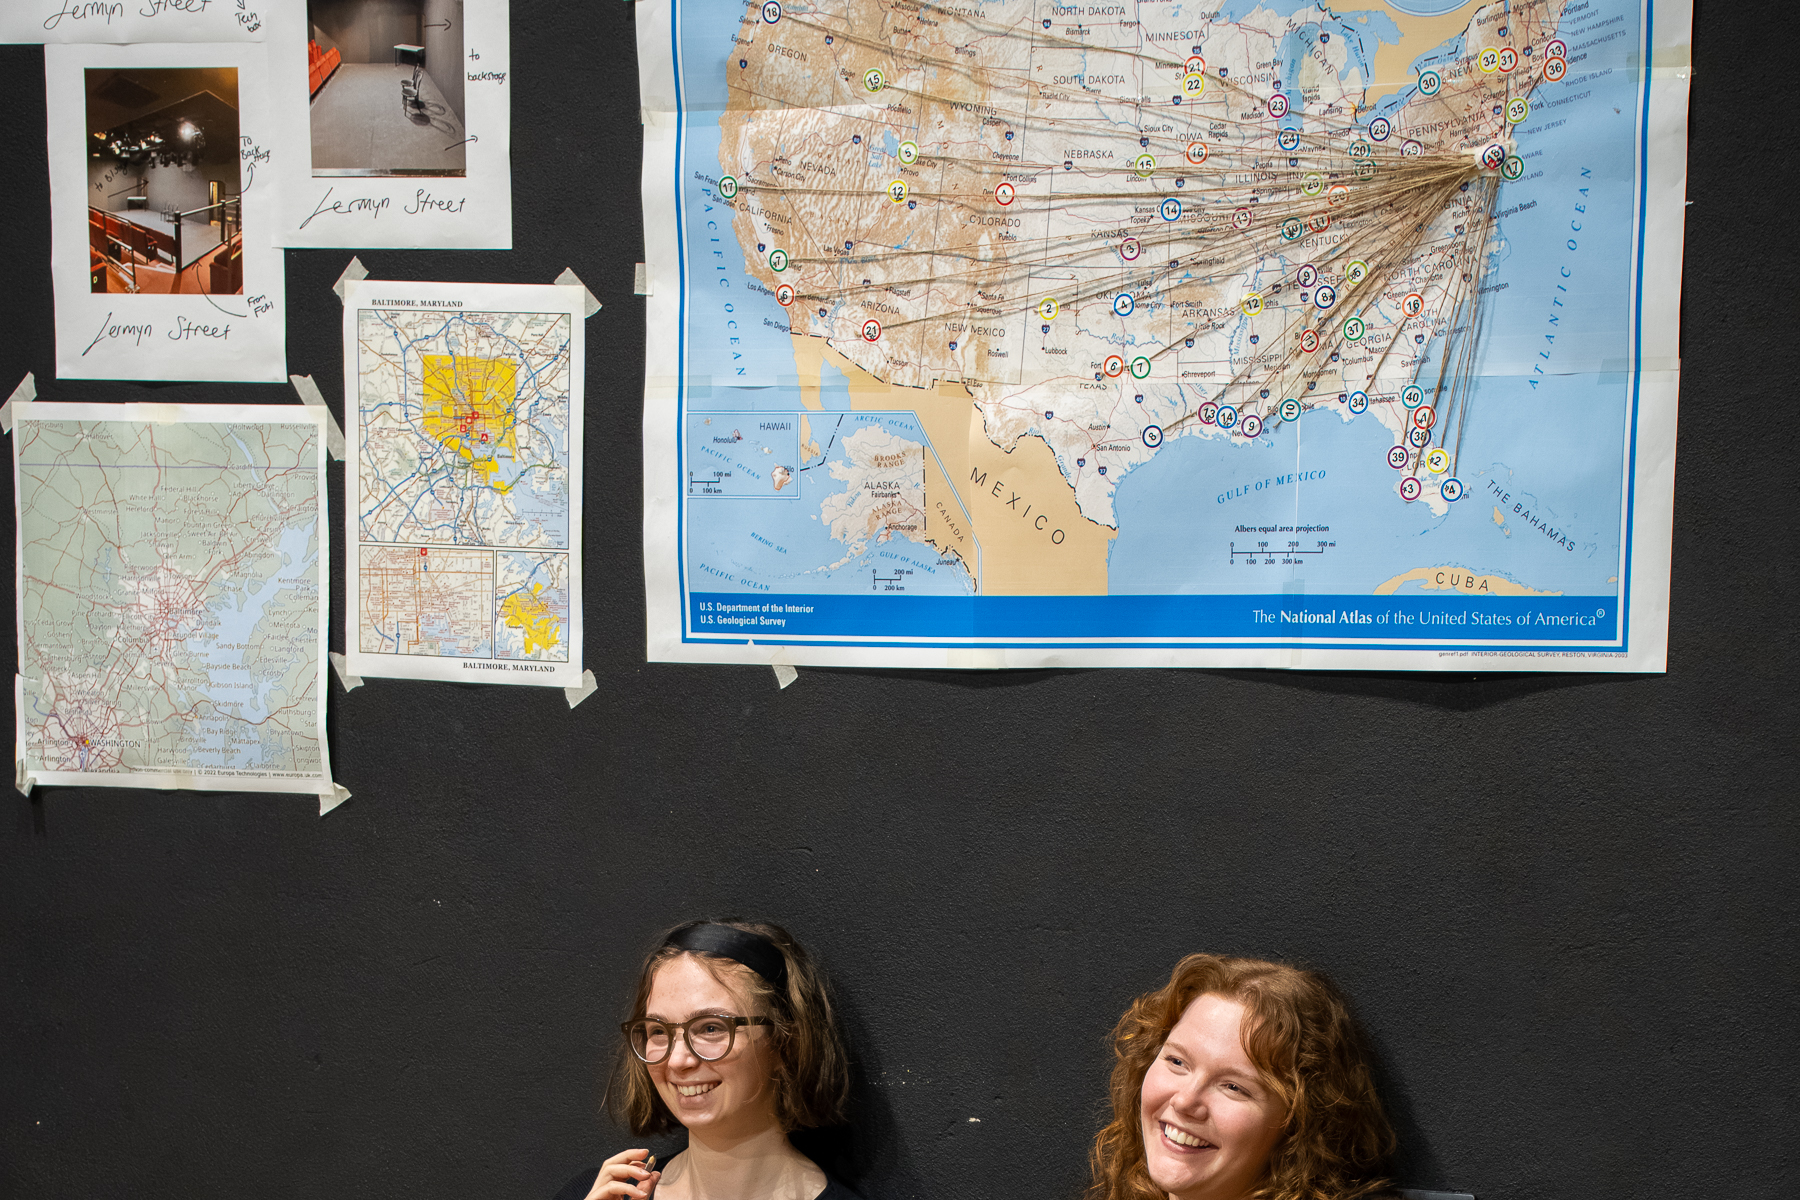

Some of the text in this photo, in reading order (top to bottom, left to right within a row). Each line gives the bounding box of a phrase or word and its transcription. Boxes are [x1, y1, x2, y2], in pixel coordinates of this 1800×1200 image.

[1052, 6, 1126, 16] NORTH DAKOTA
[1563, 1, 1590, 15] Portland
[1201, 11, 1221, 20] Duluth
[1476, 12, 1507, 26] Burlington
[1568, 9, 1600, 25] VERMONT
[1119, 19, 1137, 28] Fargo
[1066, 27, 1091, 36] Bismarck
[1145, 30, 1206, 42] MINNESOTA
[1572, 29, 1627, 52] MASSACHUSETTS
[768, 43, 808, 62] OREGON
[1286, 18, 1334, 76] MICHIGAN
[468, 48, 480, 61] to
[1483, 54, 1497, 66] 32
[1501, 54, 1514, 66] 31
[1548, 62, 1562, 74] 36
[467, 71, 506, 85] backstage
[1053, 75, 1126, 85] SOUTH DAKOTA
[1423, 77, 1436, 89] 30
[1565, 67, 1613, 88] RHODE ISLAND
[1187, 79, 1200, 91] 22
[1547, 90, 1592, 109] CONNECTICUT
[1272, 100, 1284, 111] 23
[1511, 105, 1524, 117] 35
[1240, 110, 1265, 121] Madison
[1209, 122, 1227, 130] Cedar
[1408, 111, 1486, 138] PENNSYLVANIA
[1208, 130, 1228, 140] Rapids
[1283, 134, 1296, 145] 24
[1064, 150, 1114, 159] NEBRASKA
[800, 160, 836, 177] NEVADA
[903, 167, 919, 177] Provo
[1235, 172, 1277, 184] ILLINOIS
[404, 188, 467, 214] Street
[739, 202, 793, 225] CALIFORNIA
[1134, 205, 1155, 214] Kansas
[1165, 204, 1178, 215] 14
[969, 214, 1021, 228] COLORADO
[1090, 228, 1129, 239] KANSAS
[701, 187, 747, 376] PACIFIC OCEAN
[1528, 166, 1592, 390] ATLANTIC OCEAN
[371, 299, 463, 308] BALTIMORE, MARYLAND
[861, 300, 900, 315] ARIZONA
[1246, 298, 1260, 309] 12
[1406, 299, 1420, 311] 16
[1182, 308, 1235, 318] ARKANSAS
[168, 315, 231, 340] Street
[945, 322, 1006, 337] NEW MEXICO
[1347, 322, 1360, 336] 37
[1401, 318, 1447, 332] CAROLINA
[1346, 333, 1392, 349] GEORGIA
[987, 350, 1009, 358] Roswell
[1044, 347, 1068, 355] Lubbock
[1344, 355, 1374, 366] Columbus
[1183, 370, 1216, 379] Shreveport
[1352, 397, 1365, 407] 34
[1406, 392, 1419, 402] 40
[759, 421, 791, 431] HAWAII
[854, 415, 914, 431] ARCTIC OCEAN
[1088, 423, 1106, 431] Austin
[712, 436, 737, 444] Honolulu
[1096, 443, 1131, 452] San Antonio
[874, 451, 907, 463] BROOKS
[1392, 452, 1405, 462] 39
[700, 445, 761, 481] PACIFIC OCEAN
[877, 459, 905, 468] RANGE
[864, 481, 900, 490] ALASKA
[1217, 469, 1327, 505] GULF OF MEXICO
[871, 490, 898, 499] Fairbanks
[970, 466, 1065, 545] MEXICO
[1487, 479, 1576, 552] THE BAHAMAS
[888, 523, 918, 532] Anchorage
[935, 501, 965, 543] CANADA
[1258, 524, 1277, 534] equal
[1295, 524, 1330, 534] projection
[244, 552, 275, 560] Abingdon
[935, 558, 957, 566] Juneau
[233, 571, 263, 579] Magnolia
[699, 563, 771, 592] PACIFIC OCEAN
[278, 577, 312, 585] Kentmore
[1435, 571, 1489, 591] CUBA
[700, 602, 815, 614] U.S. Department of the Interior
[700, 615, 787, 628] U.S. Geological Survey
[1252, 609, 1276, 624] The
[1280, 609, 1336, 624] National
[1339, 609, 1373, 624] Atlas
[1376, 610, 1391, 625] of
[1393, 610, 1415, 625] the
[1419, 610, 1467, 626] United
[1471, 611, 1512, 626] States
[1516, 611, 1532, 626] of
[118, 636, 150, 644] Columbia
[216, 643, 235, 651] Sandy
[274, 646, 304, 654] Langford
[206, 663, 231, 671] Bayside
[463, 662, 555, 673] BALTIMORE, MARYLAND
[270, 729, 304, 737] Bryantown
[37, 738, 69, 746] Arlington
[90, 739, 141, 748] WASHINGTON
[39, 755, 71, 763] Arlington
[235, 770, 268, 778] Technologies
